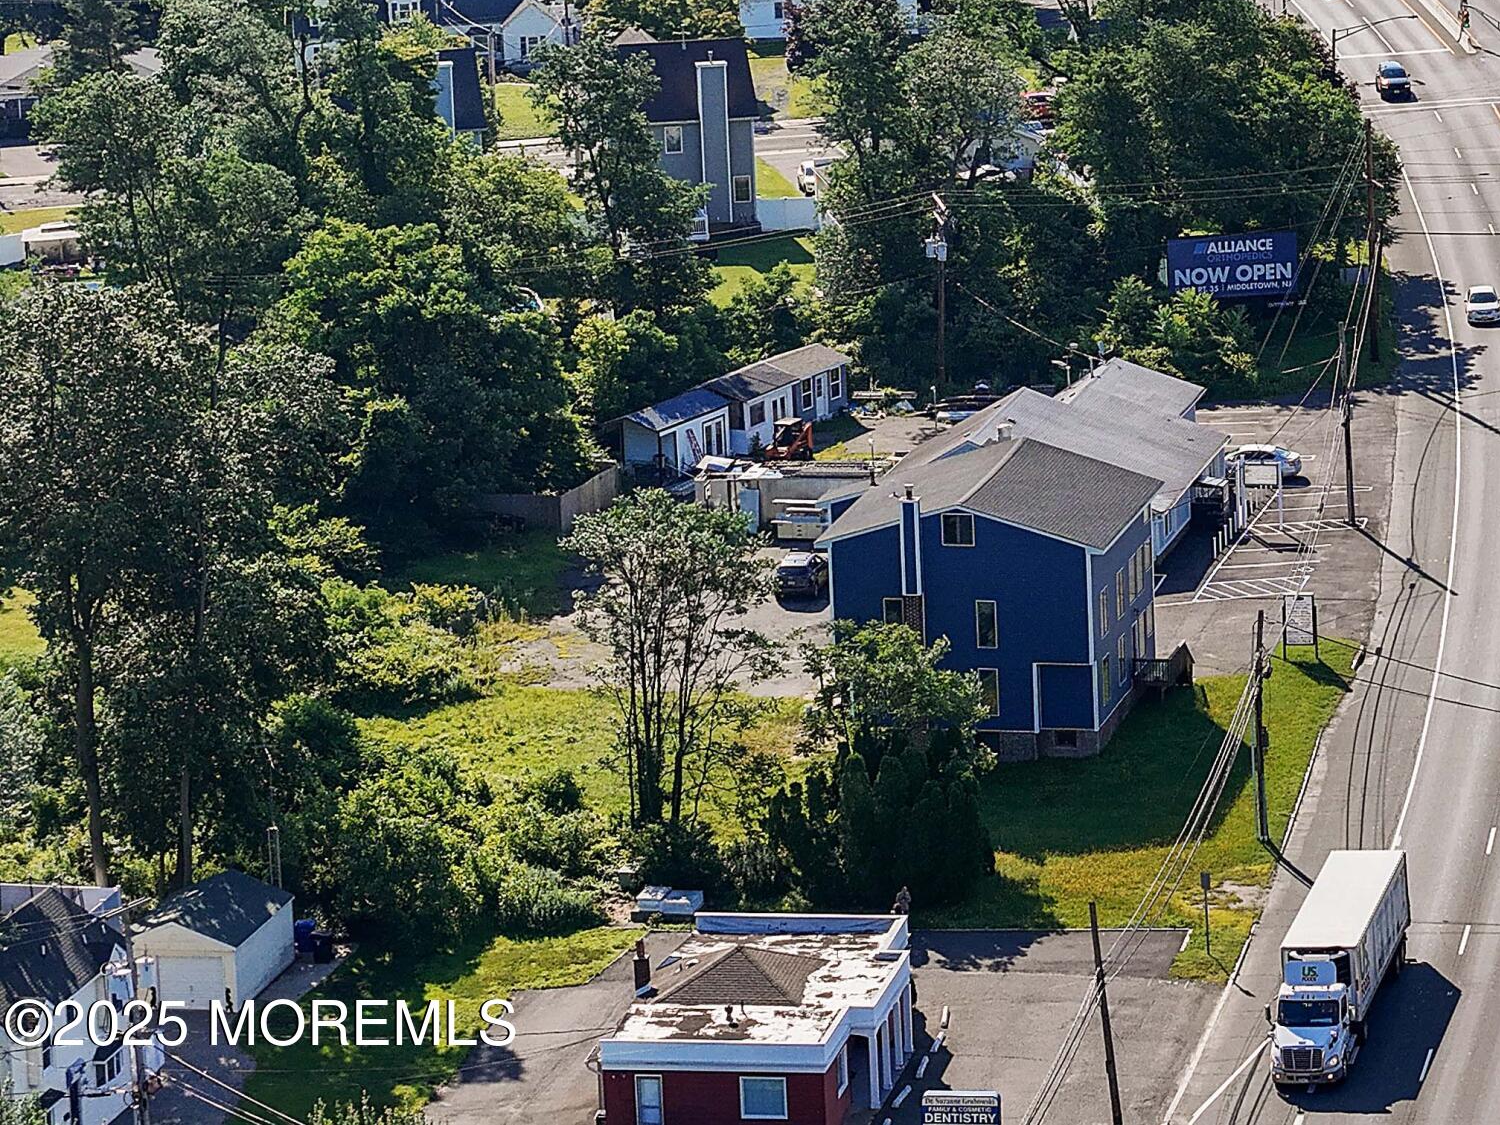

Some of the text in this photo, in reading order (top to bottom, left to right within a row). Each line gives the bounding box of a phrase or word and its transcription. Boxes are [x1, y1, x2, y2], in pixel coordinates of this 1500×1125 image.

[1207, 238, 1273, 254] ALLIANCE
[1207, 251, 1273, 263] ORTHOPEDICS
[1174, 262, 1292, 286] NOW OPEN
[1227, 281, 1280, 291] MIDDLETOWN,
[924, 1112, 996, 1123] DENTISTRY
